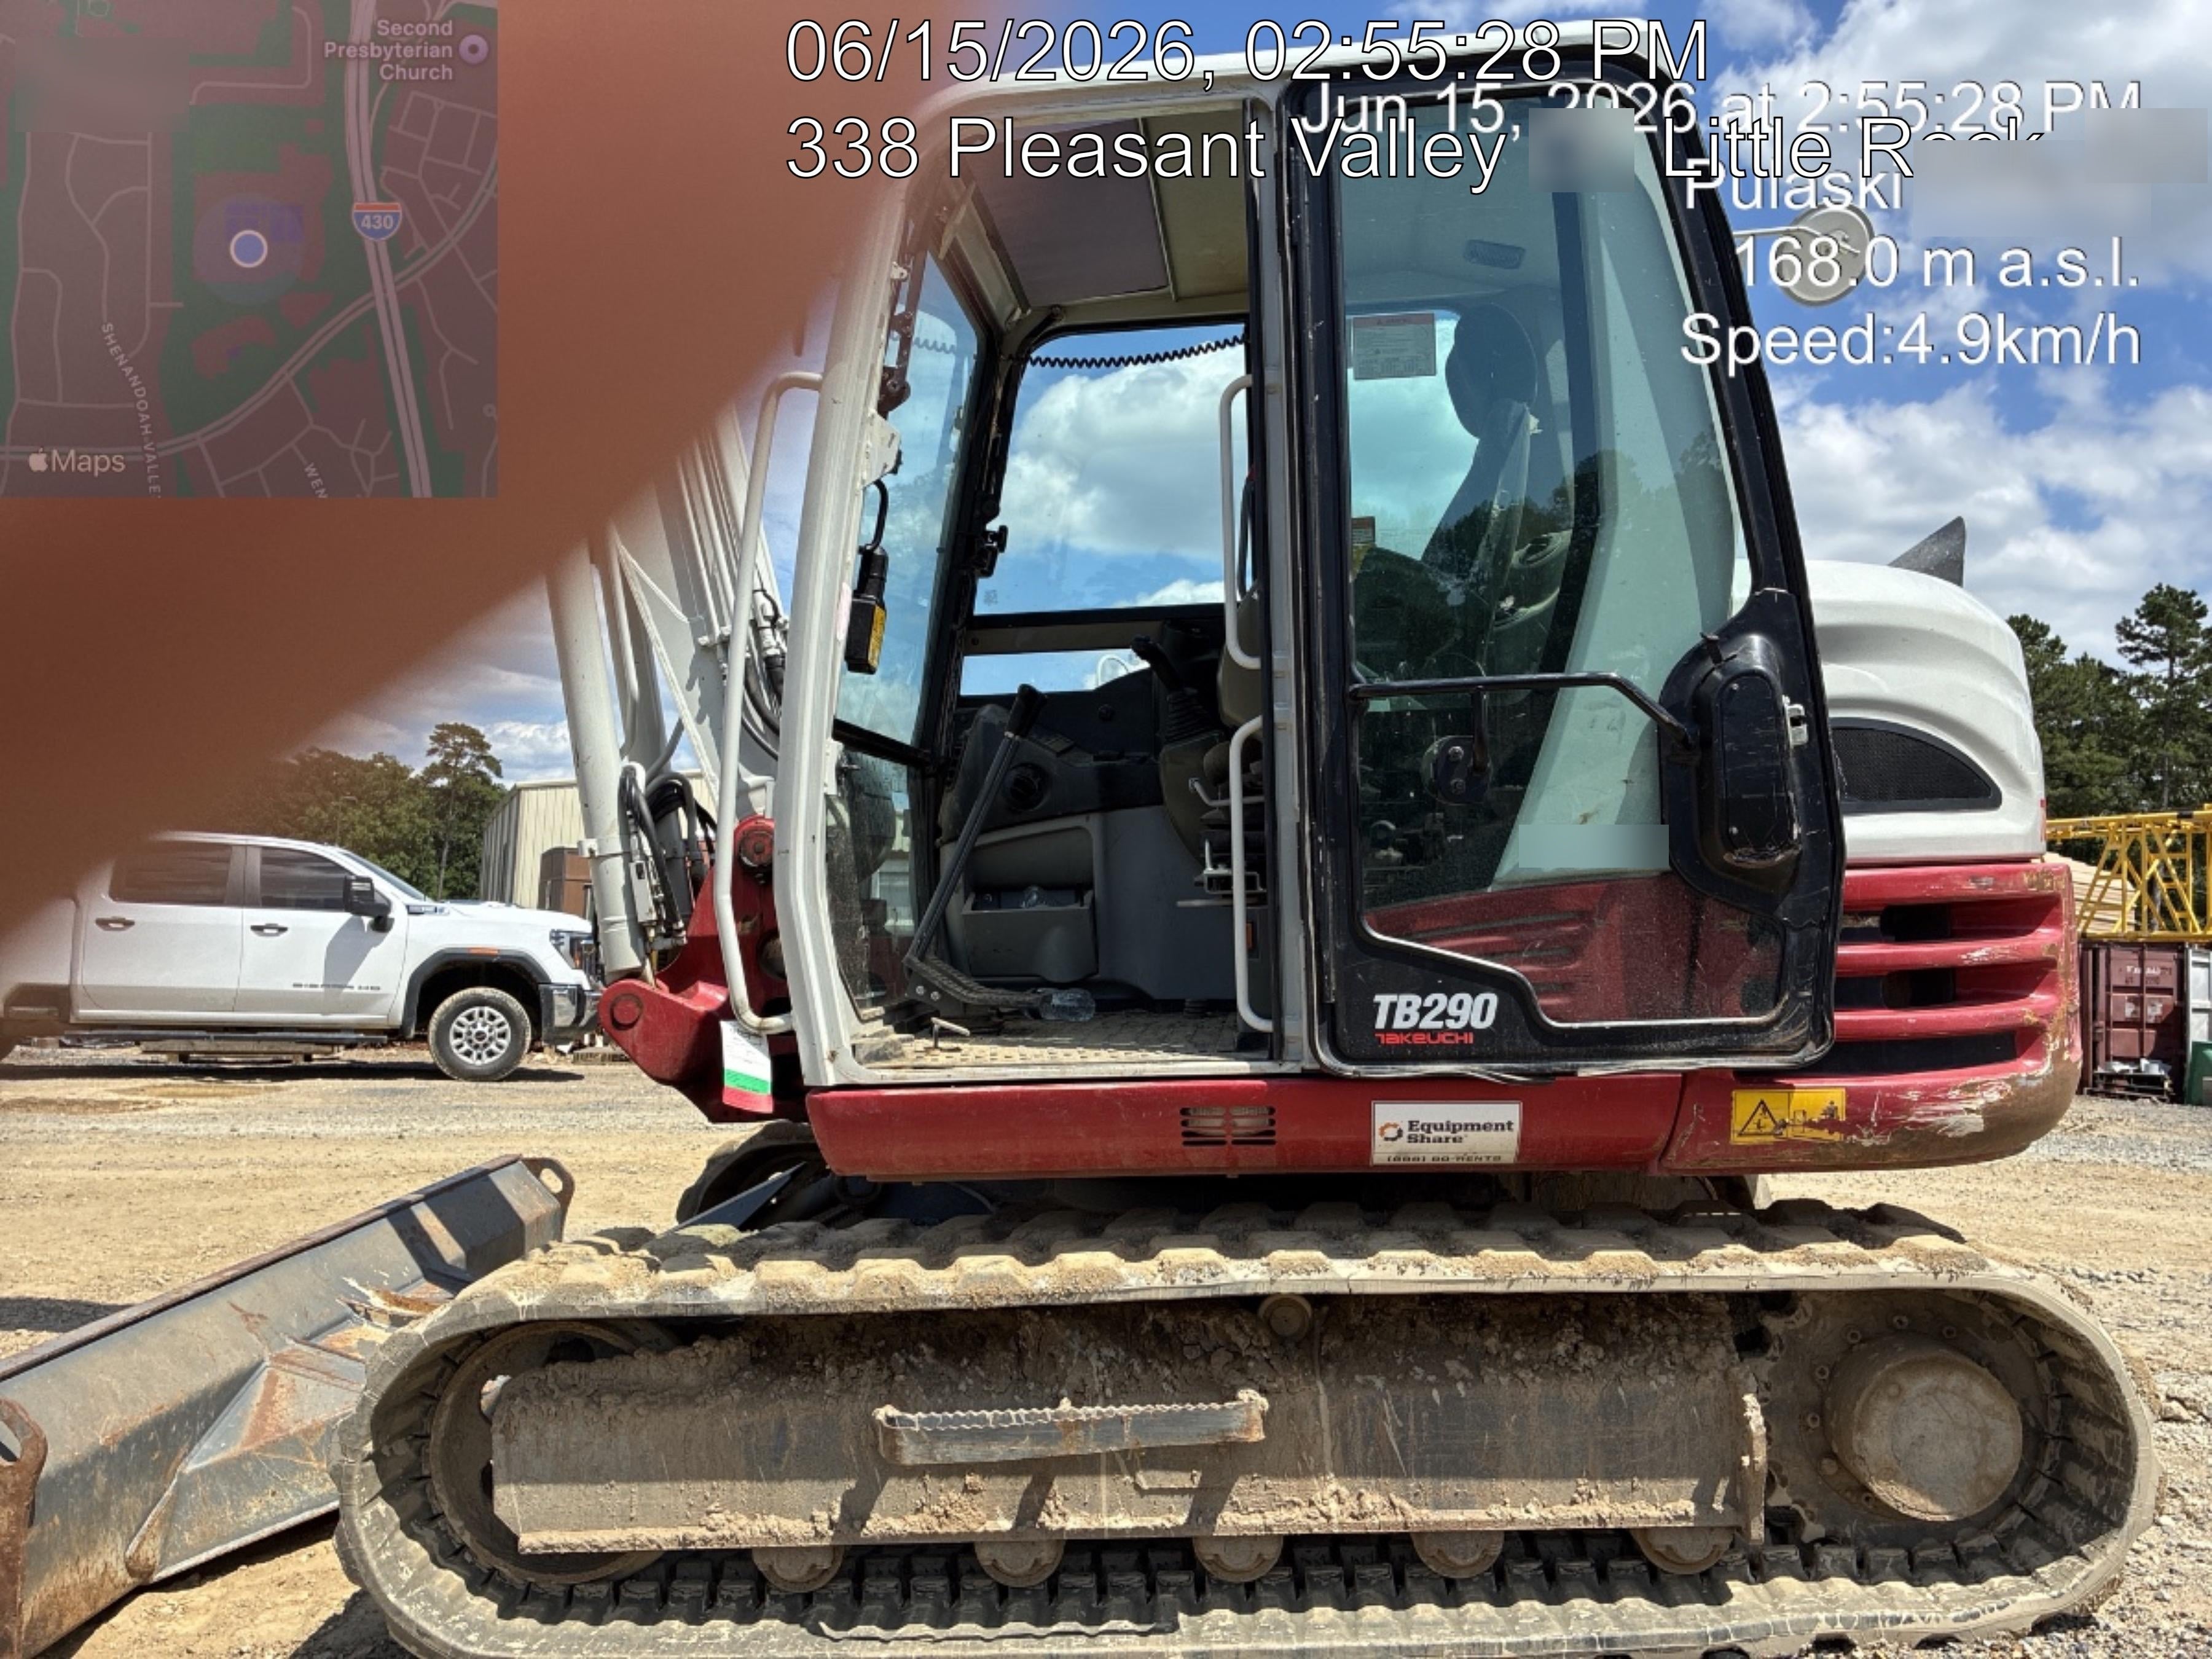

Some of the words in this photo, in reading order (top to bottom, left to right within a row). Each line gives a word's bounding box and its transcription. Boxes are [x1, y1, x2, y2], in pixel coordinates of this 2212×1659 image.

[1373, 992, 1499, 1029] TB290
[1407, 1120, 1514, 1134] Equipment
[1406, 1134, 1463, 1143] Share
